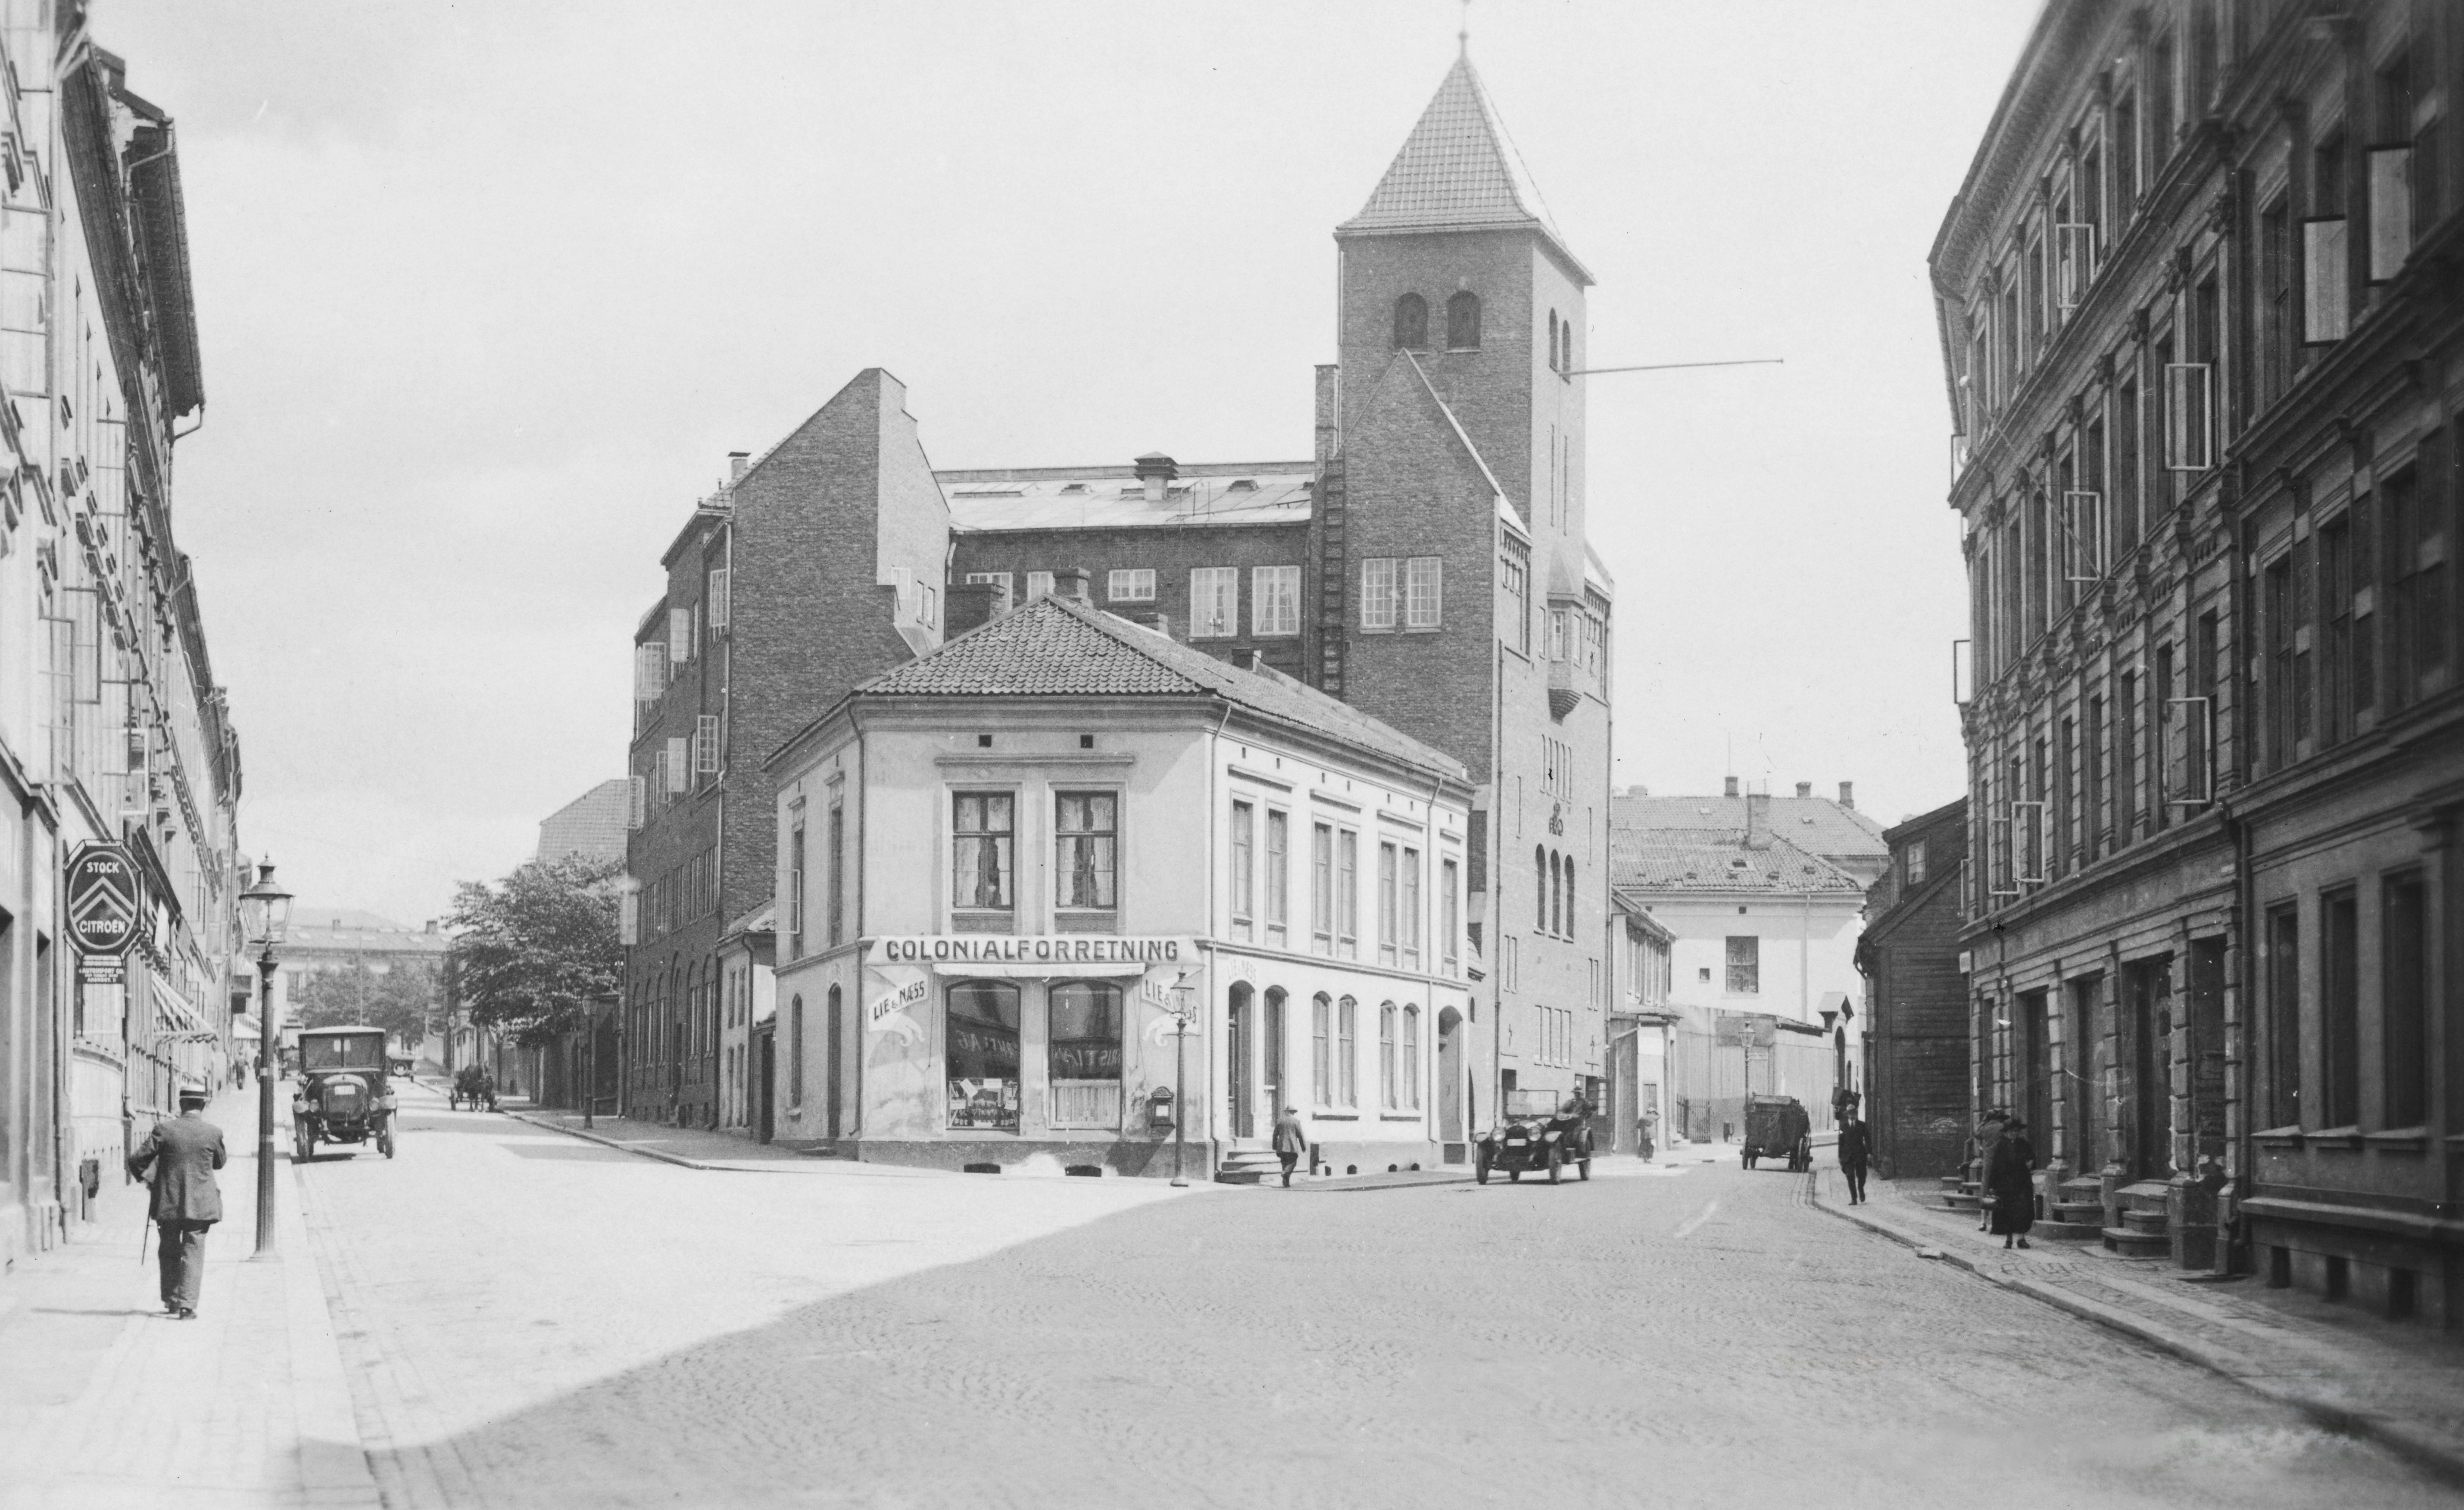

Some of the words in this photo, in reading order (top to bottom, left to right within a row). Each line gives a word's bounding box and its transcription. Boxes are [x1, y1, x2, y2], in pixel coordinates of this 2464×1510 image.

[87, 862, 120, 873] STOCK
[79, 919, 125, 933] CITROËN
[886, 940, 1178, 961] COLONIALFORRETNING
[874, 998, 890, 1021] LIE
[891, 999, 900, 1009] &
[900, 981, 924, 1005] NÆSS
[1145, 979, 1162, 1002] LIE
